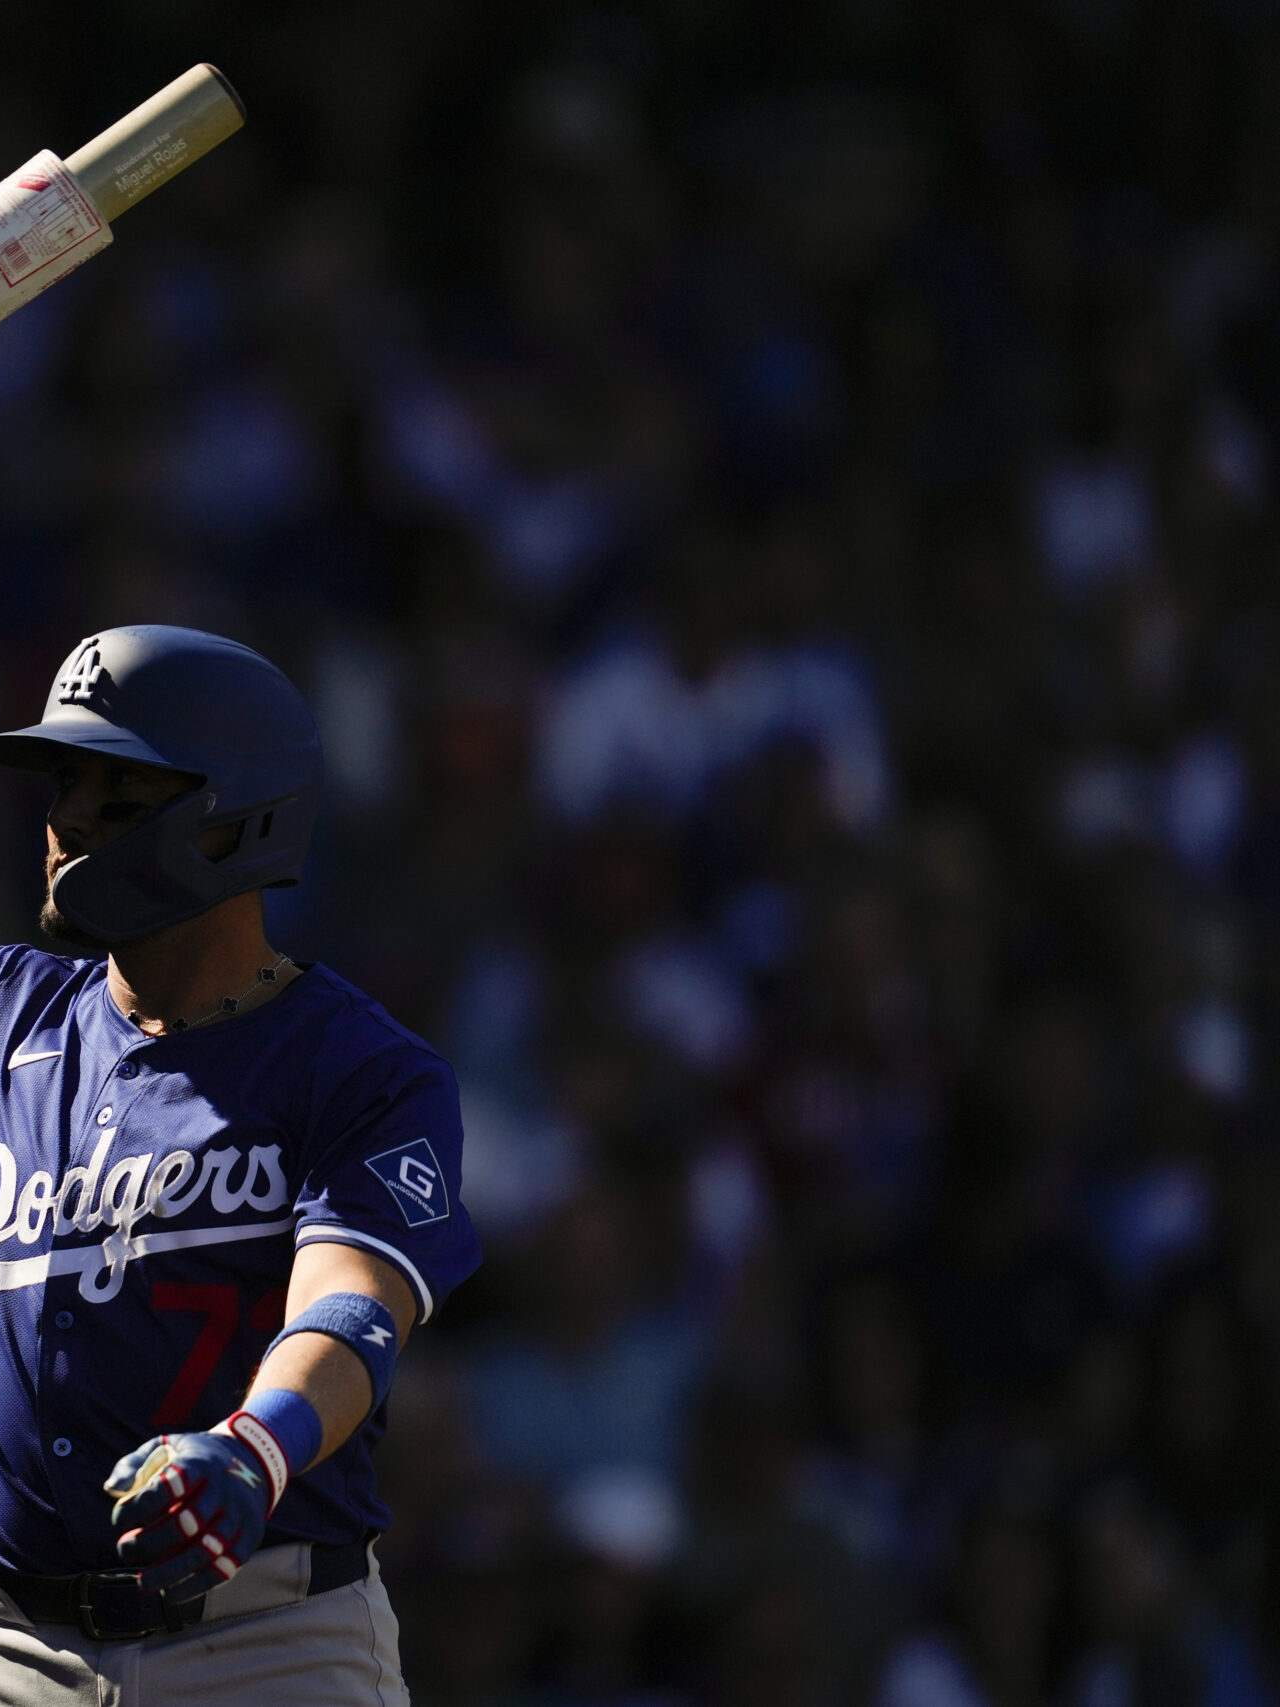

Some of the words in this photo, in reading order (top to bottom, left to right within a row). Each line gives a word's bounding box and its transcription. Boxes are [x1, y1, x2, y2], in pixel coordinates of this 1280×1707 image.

[115, 158, 155, 193] Miguel
[151, 138, 187, 167] Rojas
[58, 638, 102, 701] LA
